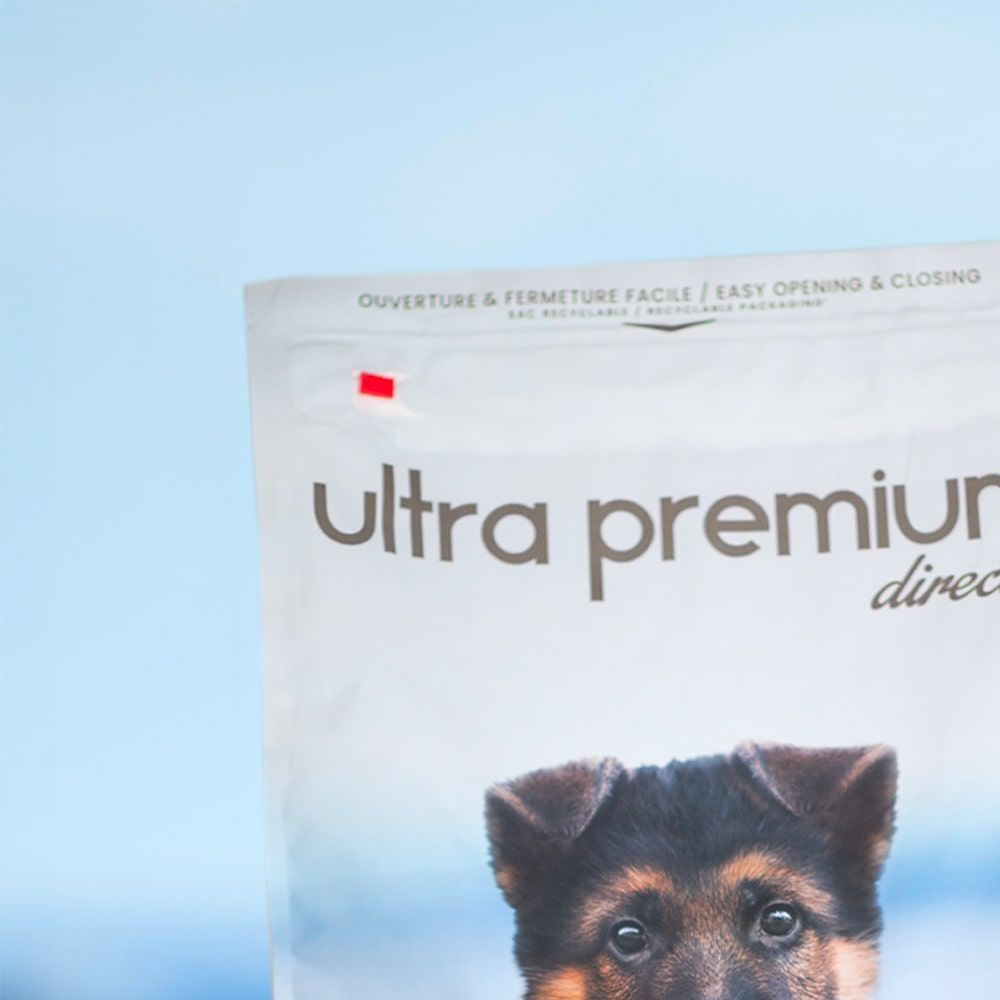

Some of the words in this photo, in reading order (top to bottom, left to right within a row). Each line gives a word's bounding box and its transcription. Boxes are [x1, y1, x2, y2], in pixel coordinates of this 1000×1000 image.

[358, 293, 476, 310] OUVERTURE
[504, 288, 618, 305] FERMETURE
[626, 286, 692, 303] FACILE
[716, 283, 766, 300] EASY
[772, 277, 863, 297] OPENING
[890, 268, 982, 289] CLOSING
[313, 463, 550, 565] ultra
